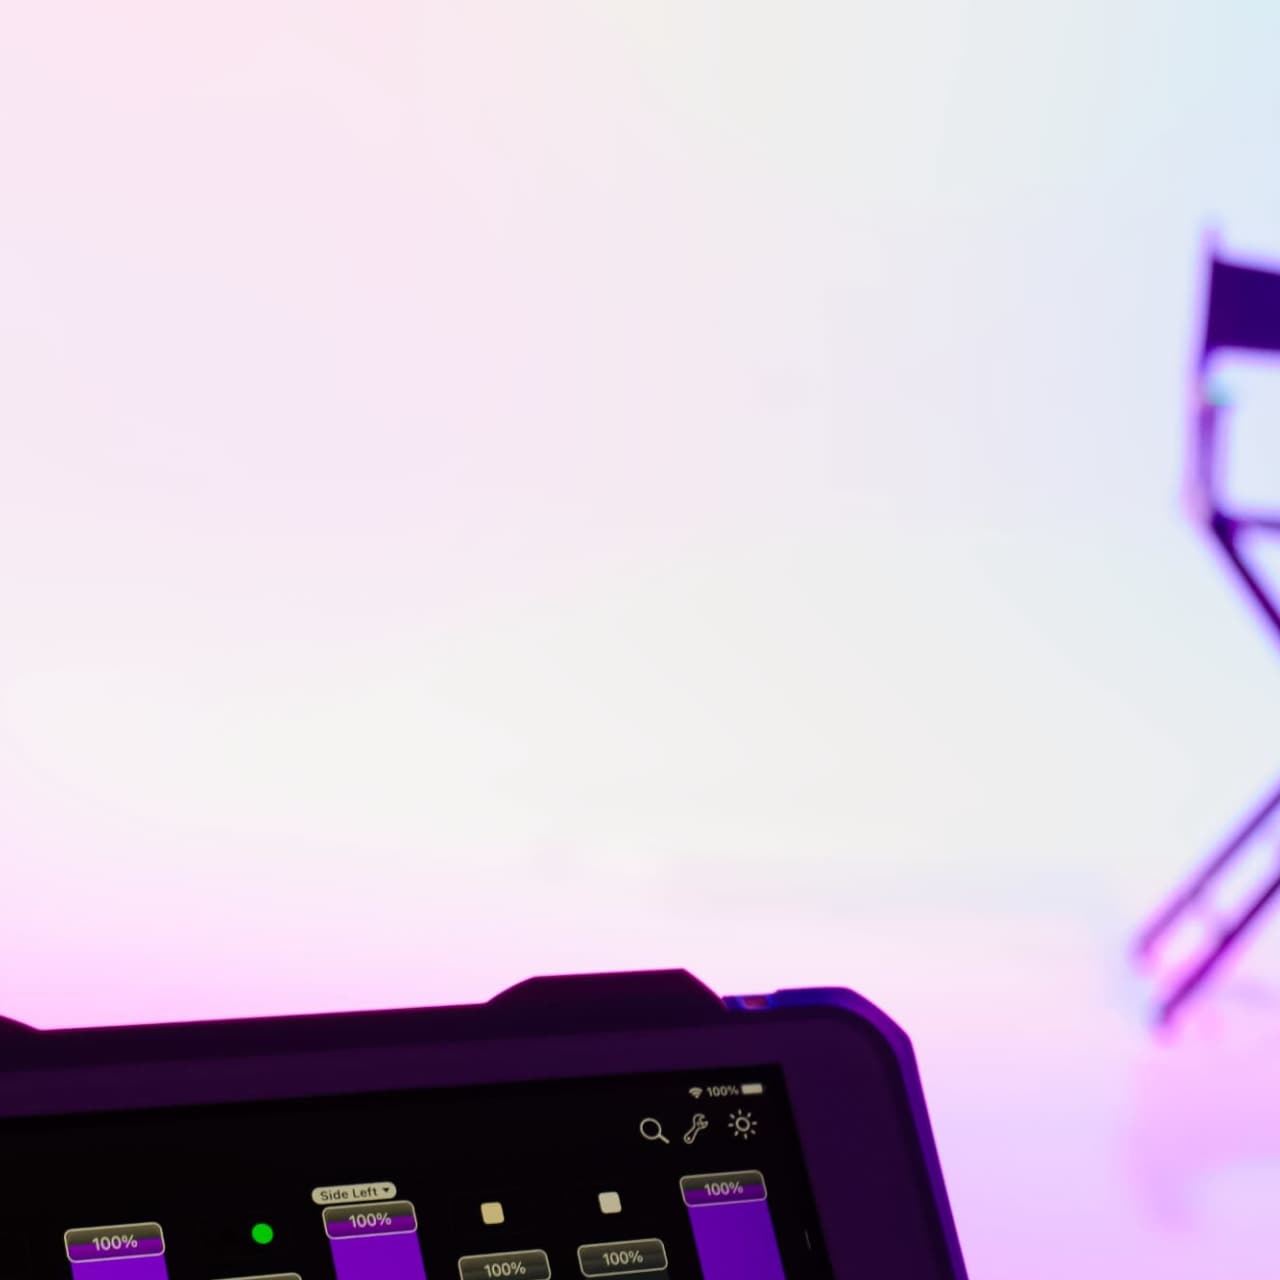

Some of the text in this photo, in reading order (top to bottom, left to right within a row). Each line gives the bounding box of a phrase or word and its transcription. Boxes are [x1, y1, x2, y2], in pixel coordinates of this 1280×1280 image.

[706, 1085, 739, 1097] 100%
[319, 1186, 378, 1201] Side Left
[703, 1181, 744, 1197] 100%
[348, 1212, 392, 1229] 100%
[92, 1235, 138, 1251] 100%
[602, 1250, 644, 1266] 100%
[483, 1262, 526, 1278] 100%
